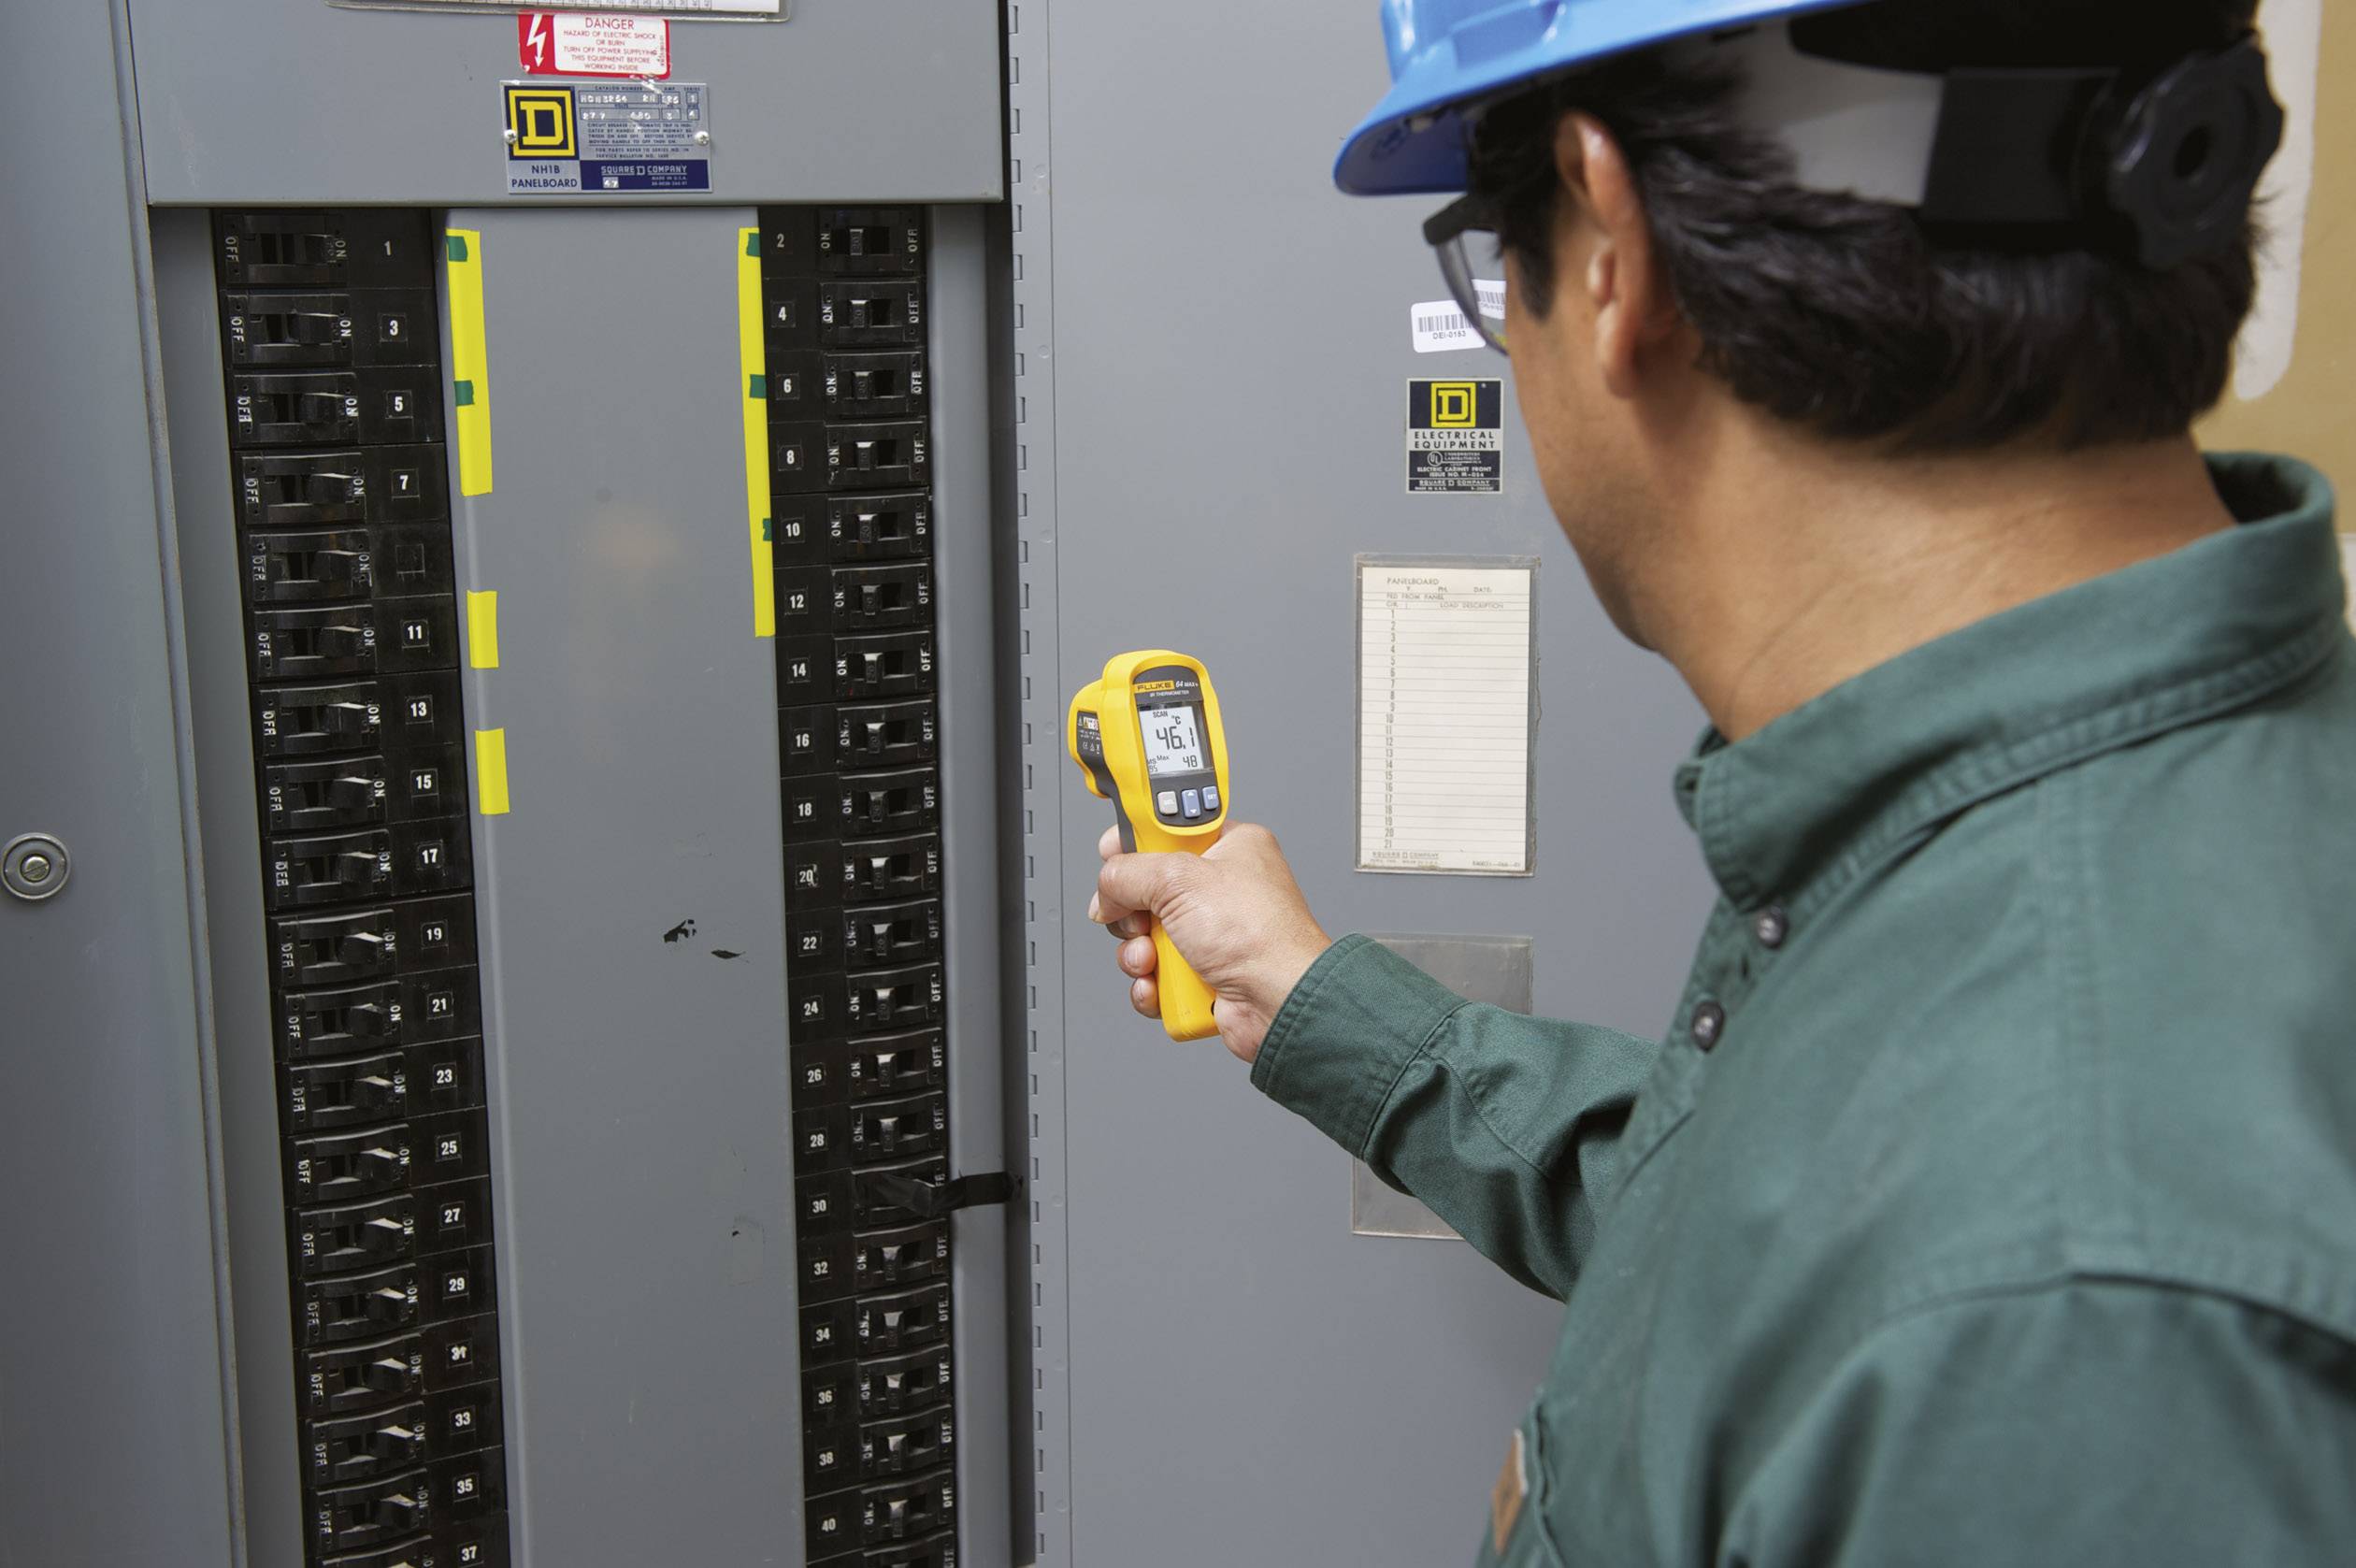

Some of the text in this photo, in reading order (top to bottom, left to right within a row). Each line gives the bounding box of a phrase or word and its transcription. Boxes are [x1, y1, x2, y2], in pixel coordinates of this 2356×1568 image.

[585, 17, 634, 29] DANGER
[532, 165, 560, 174] NH1B
[637, 166, 645, 175] D
[511, 178, 577, 188] PANELBOARD
[384, 240, 391, 256] 1
[777, 234, 785, 247] 2
[821, 233, 830, 249] ON
[908, 229, 917, 252] OFF
[225, 236, 239, 262] OFF
[335, 240, 347, 258] ON
[778, 306, 787, 321] 4
[231, 317, 245, 342] OFF
[340, 319, 352, 337] ON
[389, 320, 399, 336] 3
[783, 379, 792, 393] 6
[826, 376, 836, 394] ON
[911, 371, 922, 394] OFF
[395, 396, 403, 412] 5
[1415, 431, 1494, 439] ELECTRICAL
[914, 441, 924, 462] OFF
[1415, 441, 1495, 449] EQUIPMENT
[786, 450, 794, 464] 8
[828, 447, 839, 464] ON
[353, 478, 365, 495] ON
[400, 475, 409, 490] 7
[246, 478, 259, 504] OFF
[786, 522, 800, 536] 10
[831, 521, 841, 536] ON
[916, 513, 926, 534] OFF
[790, 594, 804, 608] 12
[835, 591, 844, 607] ON
[918, 584, 928, 604] OFF
[363, 629, 375, 646] ON
[407, 625, 422, 640] 11
[258, 633, 271, 657] OFF
[837, 660, 847, 675] ON
[921, 650, 930, 671] OFF
[792, 663, 806, 677] 14
[368, 704, 380, 724] ON
[411, 702, 427, 717] 13
[263, 711, 276, 736] OFF
[796, 733, 809, 747] 16
[1156, 726, 1195, 750] 46.1
[1183, 755, 1198, 767] 48
[374, 778, 385, 797] ON
[416, 775, 432, 789] 15
[269, 787, 283, 812] OFF
[843, 798, 852, 813] ON
[924, 788, 934, 808] OFF
[798, 803, 812, 816] 18
[422, 849, 438, 864] 17
[928, 852, 937, 873] OFF
[800, 869, 813, 883] 20
[845, 864, 854, 880] ON
[426, 927, 442, 941] 19
[385, 934, 395, 951] ON
[803, 937, 817, 950] 22
[281, 943, 294, 968] OFF
[932, 981, 941, 1001] OFF
[432, 998, 447, 1013] 21
[804, 1001, 818, 1015] 24
[850, 997, 859, 1012] ON
[390, 1006, 401, 1021] ON
[288, 1017, 300, 1038] OFF
[436, 1069, 453, 1084] 23
[808, 1069, 822, 1083] 26
[441, 1141, 457, 1155] 25
[810, 1134, 824, 1147] 28
[399, 1149, 410, 1165] ON
[298, 1160, 311, 1183] OFF
[813, 1200, 826, 1213] 30
[444, 1208, 460, 1223] 27
[403, 1218, 414, 1235] ON
[303, 1233, 314, 1256] OFF
[814, 1262, 828, 1275] 32
[449, 1278, 465, 1291] 29
[816, 1328, 830, 1342] 34
[819, 1391, 832, 1404] 36
[455, 1412, 471, 1427] 33
[415, 1424, 425, 1441] ON
[315, 1444, 327, 1466] OFF
[819, 1452, 833, 1466] 38
[457, 1479, 473, 1494] 35
[419, 1491, 429, 1508] ON
[319, 1511, 332, 1533] OFF
[822, 1518, 836, 1532] 40
[462, 1545, 477, 1561] 37
